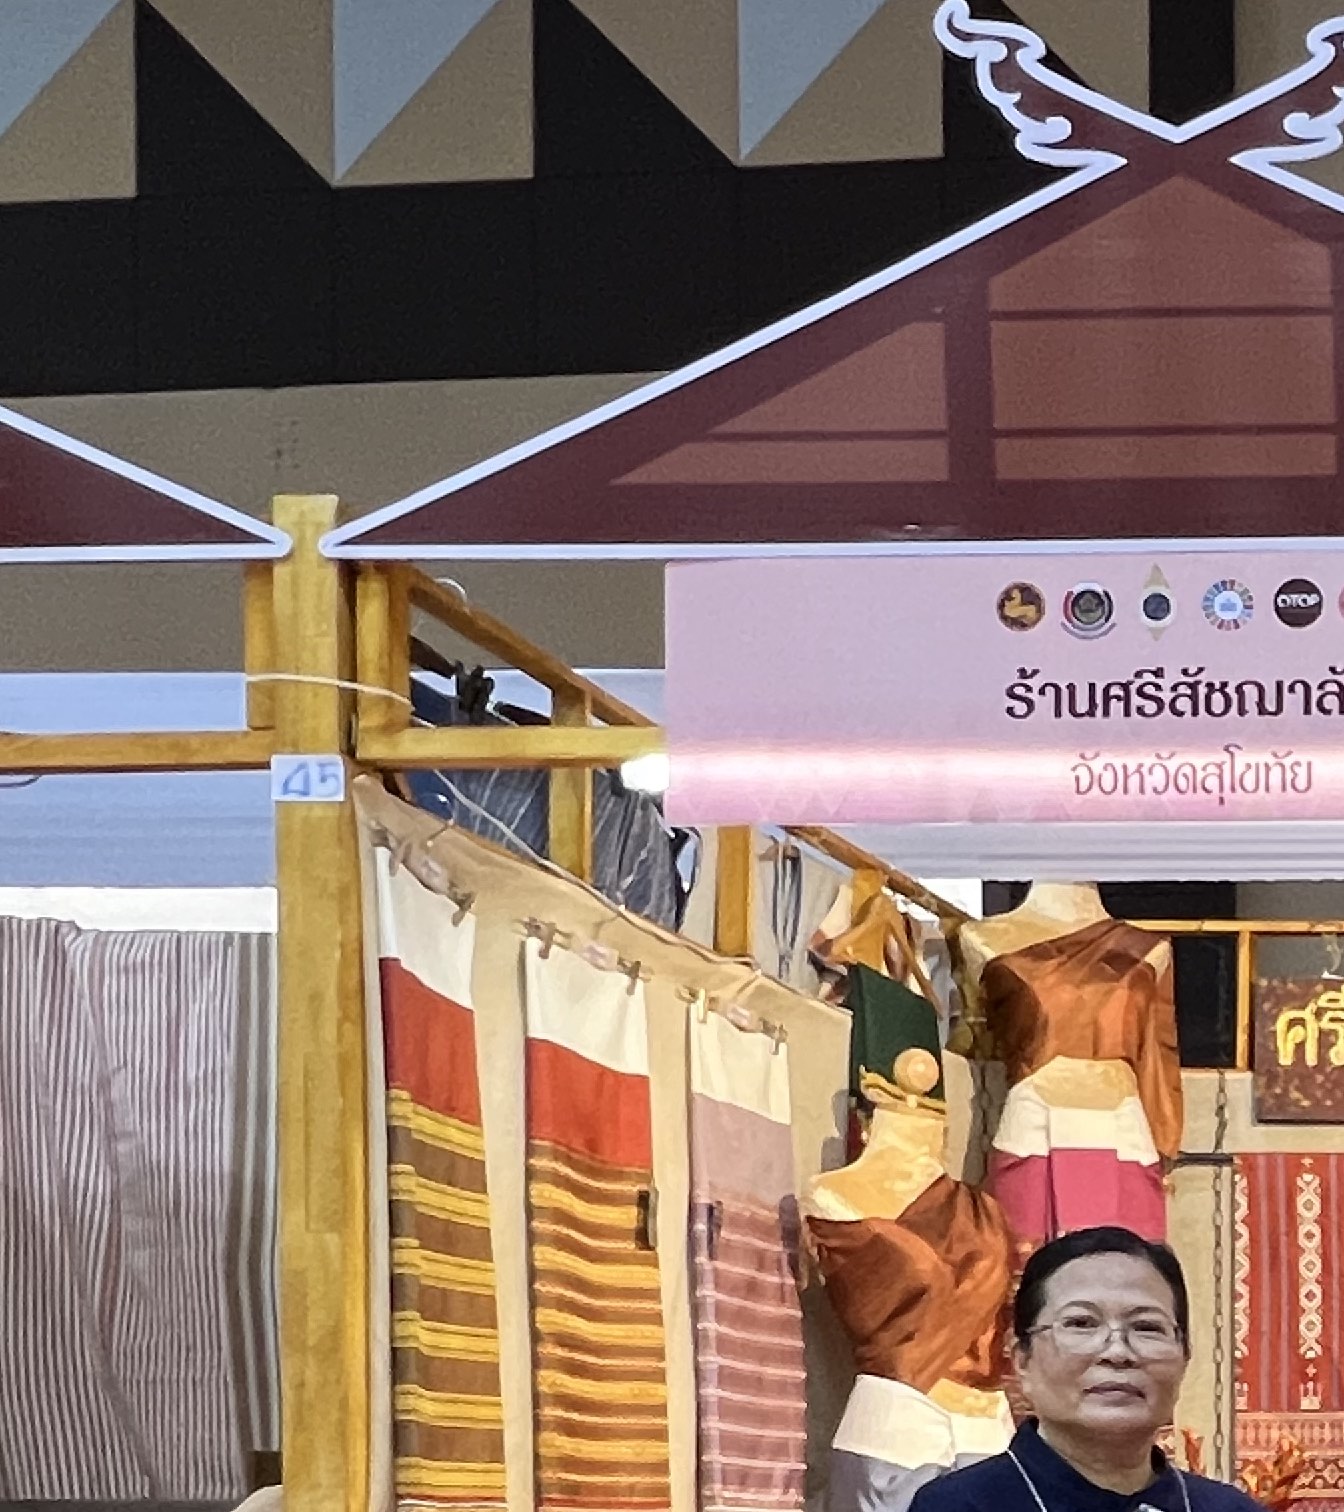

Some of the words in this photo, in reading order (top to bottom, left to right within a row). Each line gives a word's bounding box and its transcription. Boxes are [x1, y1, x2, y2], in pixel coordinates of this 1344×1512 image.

[281, 761, 341, 797] 45
[1070, 743, 1313, 806] จังหวัดสุโขทัย
